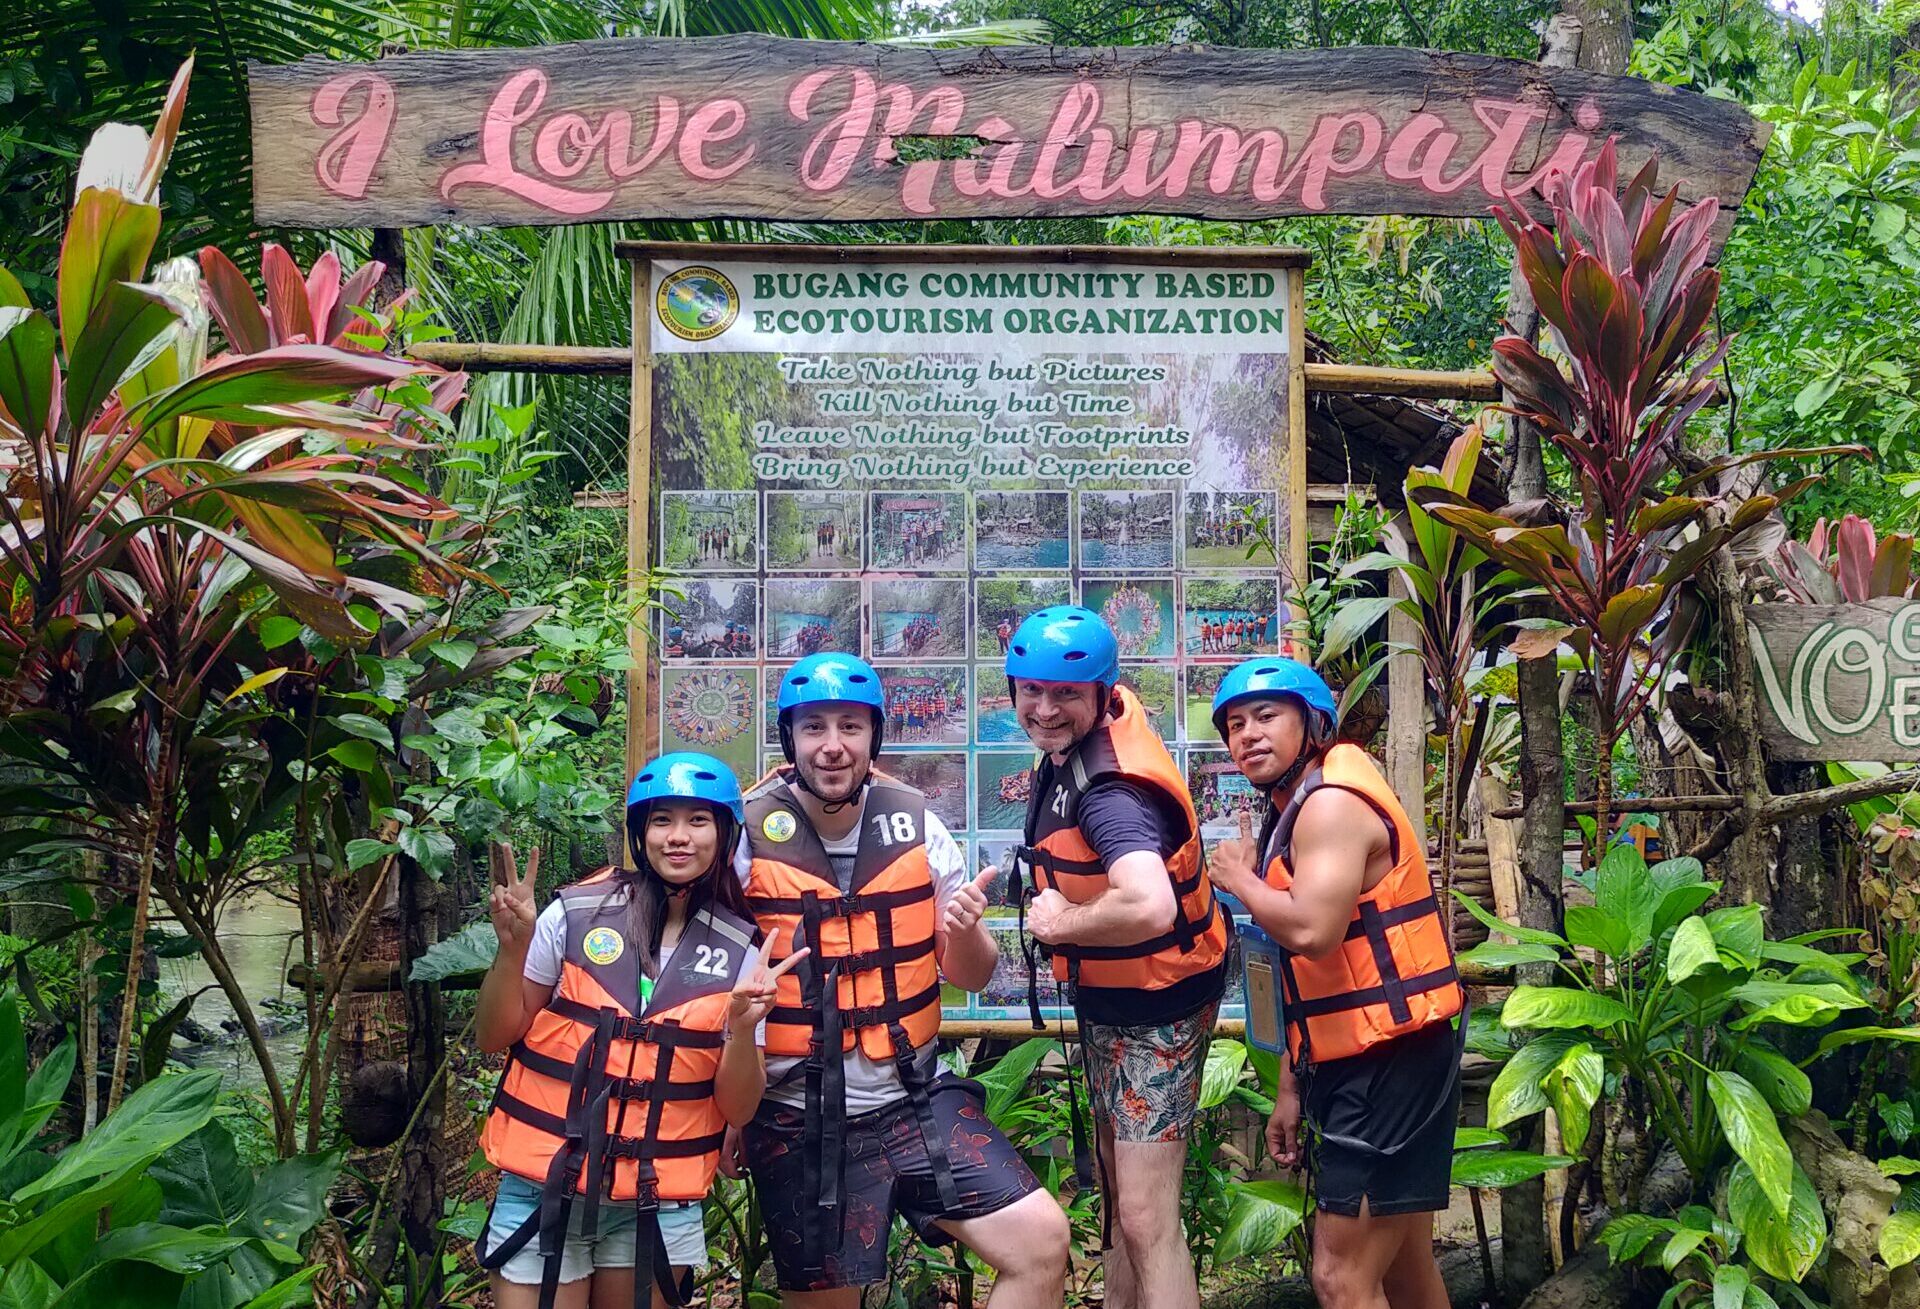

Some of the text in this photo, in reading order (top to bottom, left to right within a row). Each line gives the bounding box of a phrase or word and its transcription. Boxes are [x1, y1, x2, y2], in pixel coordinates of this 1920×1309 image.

[438, 66, 756, 215] Love
[786, 66, 1602, 214] Malumpati
[752, 272, 1275, 300] BUGANG COMMUNITY BASED
[753, 308, 1285, 335] ECOTOURISM ORGANIZATION
[780, 360, 1166, 389] Take Nothing but Pictures
[819, 392, 1132, 420] Kill Nothing but Time
[757, 423, 1190, 453] Leave Nothing but Footprints
[756, 455, 1193, 485] Bring Nothing but Experience
[1051, 783, 1069, 819] 21
[871, 811, 917, 847] 18
[693, 943, 730, 979] 22
